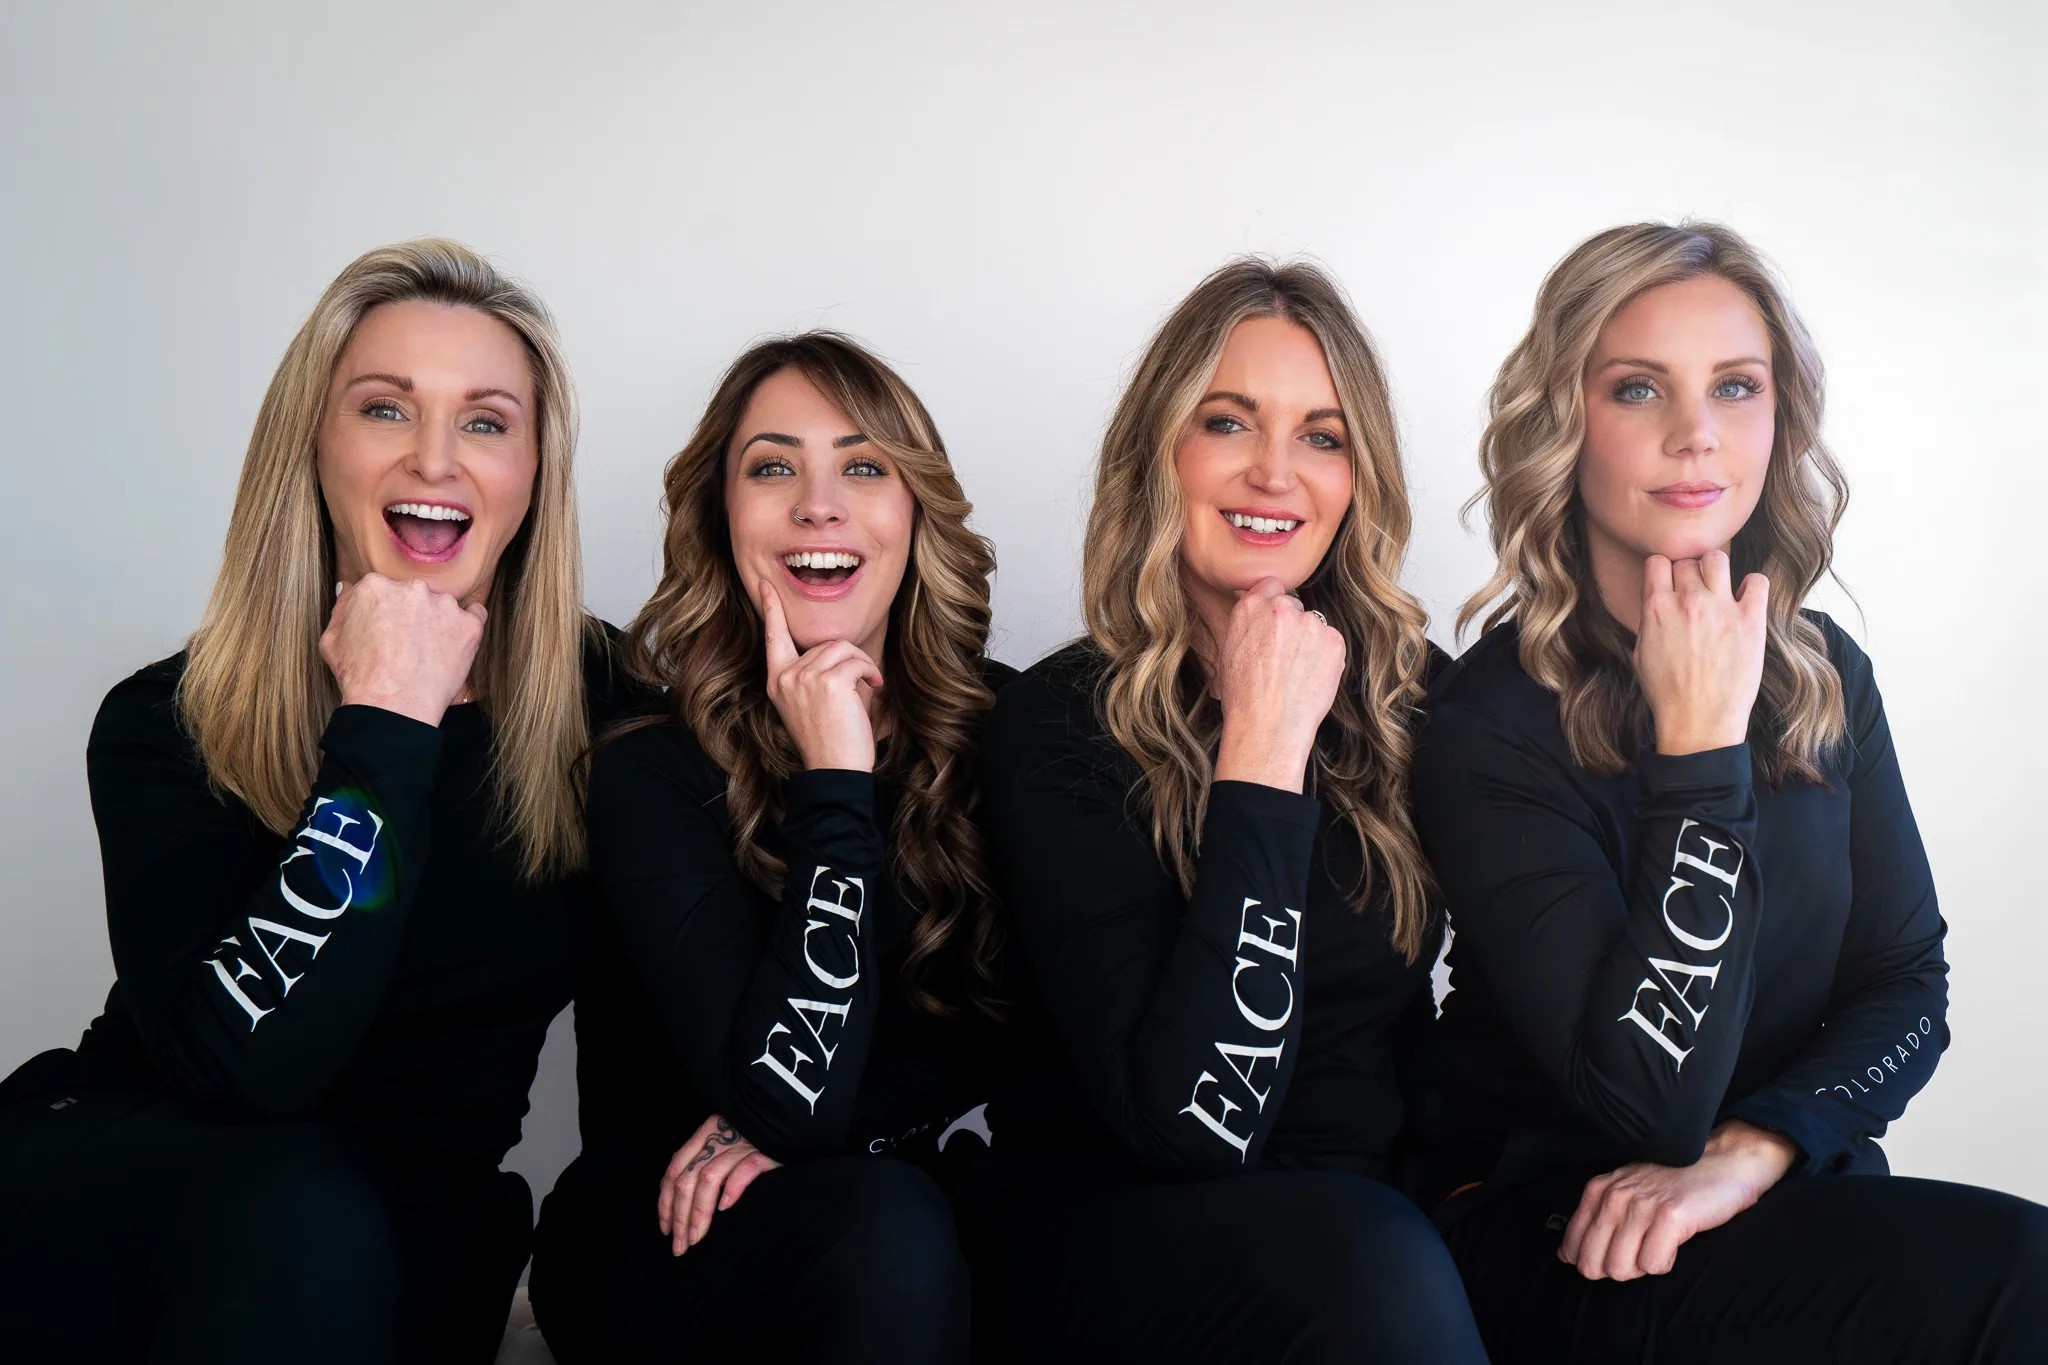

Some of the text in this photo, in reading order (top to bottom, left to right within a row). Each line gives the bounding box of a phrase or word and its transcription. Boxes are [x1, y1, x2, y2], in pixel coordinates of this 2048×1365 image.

[204, 796, 384, 1032] FACE
[751, 865, 865, 1115] FACE
[1179, 897, 1302, 1162] FACE
[1618, 818, 1744, 1073] FACE
